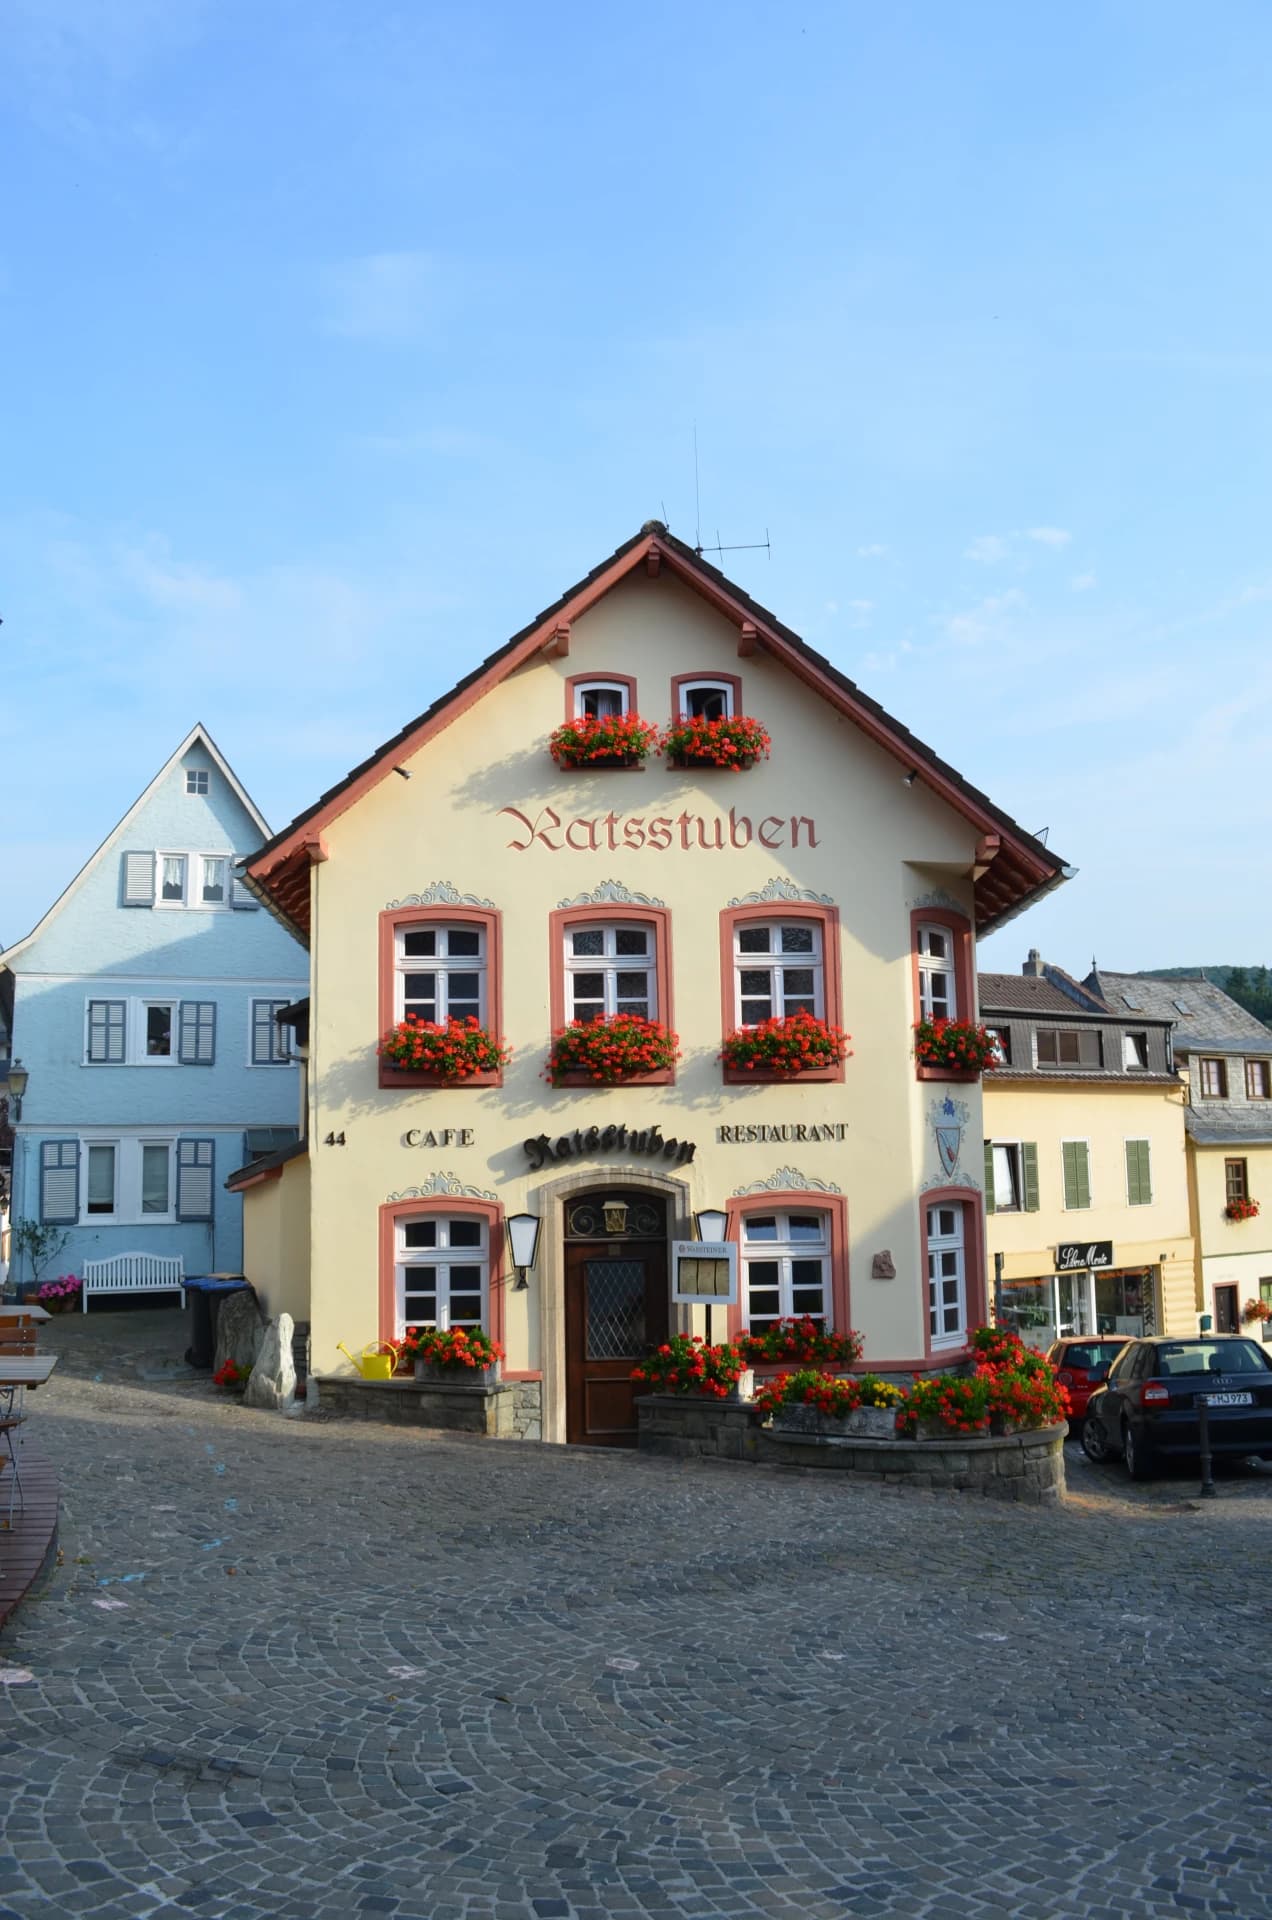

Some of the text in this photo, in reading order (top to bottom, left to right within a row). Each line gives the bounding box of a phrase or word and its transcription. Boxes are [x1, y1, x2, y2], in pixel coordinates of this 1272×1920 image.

[495, 806, 822, 851] Ratsstuben
[325, 1131, 347, 1147] 44
[405, 1128, 475, 1147] CAFE
[719, 1123, 849, 1143] RESTAURANT
[523, 1123, 697, 1169] Ratsstuben
